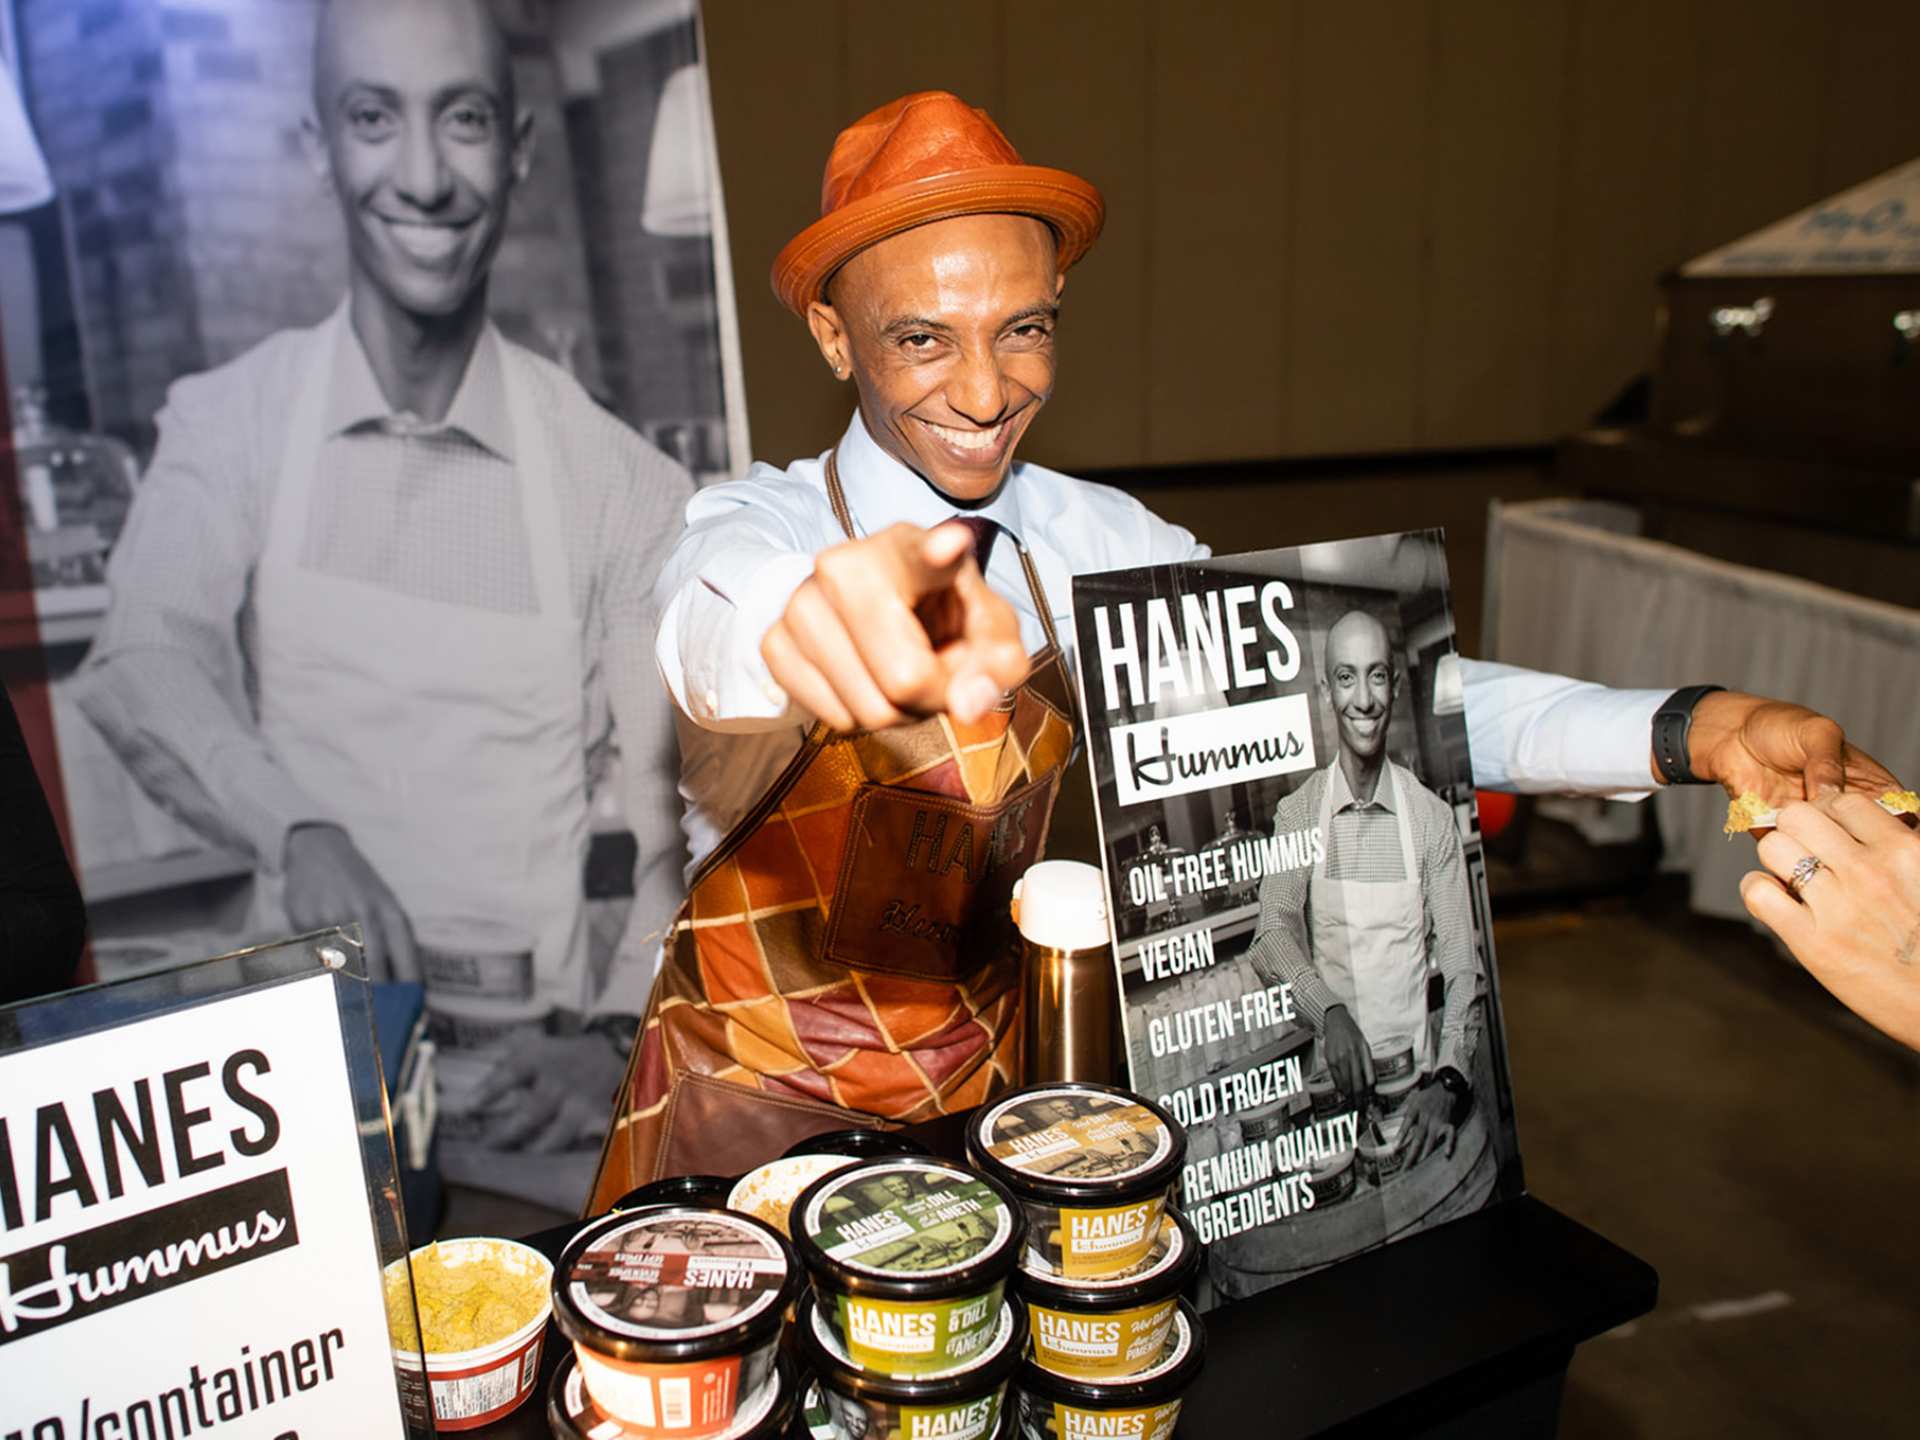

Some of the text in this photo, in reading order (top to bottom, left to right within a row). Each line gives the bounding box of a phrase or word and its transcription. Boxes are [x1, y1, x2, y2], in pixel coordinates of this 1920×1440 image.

[1094, 581, 1301, 711] HANES
[1127, 726, 1304, 791] Hummus
[1129, 827, 1325, 906] OIL-FREE HUMMUS
[1138, 927, 1216, 982] VEGAN
[1149, 983, 1297, 1058] GLUTEN-FREE
[1219, 1056, 1304, 1115] FROZEN
[1009, 1127, 1069, 1153] HANES
[1275, 1111, 1359, 1172] QUALITY
[835, 1210, 902, 1241] HANES
[1071, 1205, 1148, 1238] HANES
[0, 1209, 287, 1333] Hummus
[683, 1269, 755, 1289] HANES
[847, 1302, 936, 1336] HANES
[1038, 1311, 1120, 1343] HANES
[911, 1396, 992, 1437] HANES
[1064, 1410, 1146, 1436] HANES
